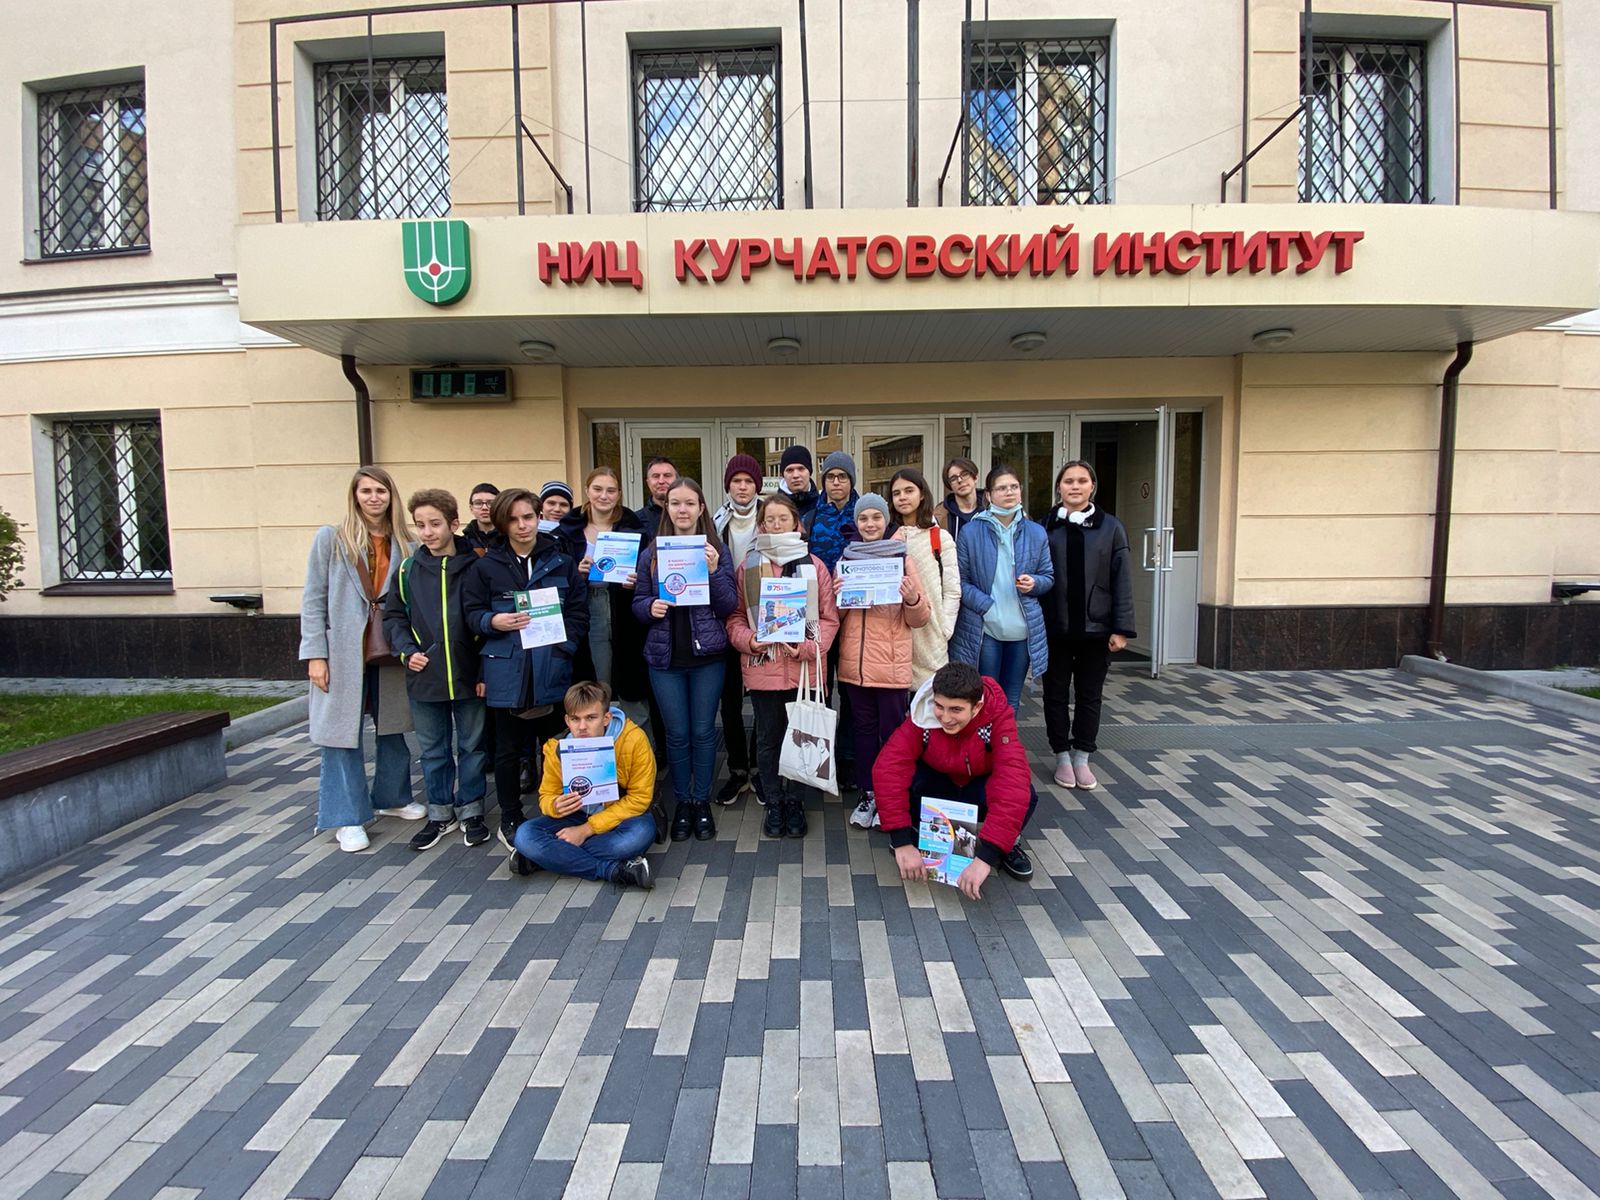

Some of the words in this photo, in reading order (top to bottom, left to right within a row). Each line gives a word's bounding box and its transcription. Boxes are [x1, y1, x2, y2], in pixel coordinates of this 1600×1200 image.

[538, 240, 643, 290] НИЦ
[674, 224, 1080, 284] КУРЧАТОВСКИЙ
[1093, 230, 1365, 276] ИНСТИТУТ
[763, 481, 780, 489] ХОД
